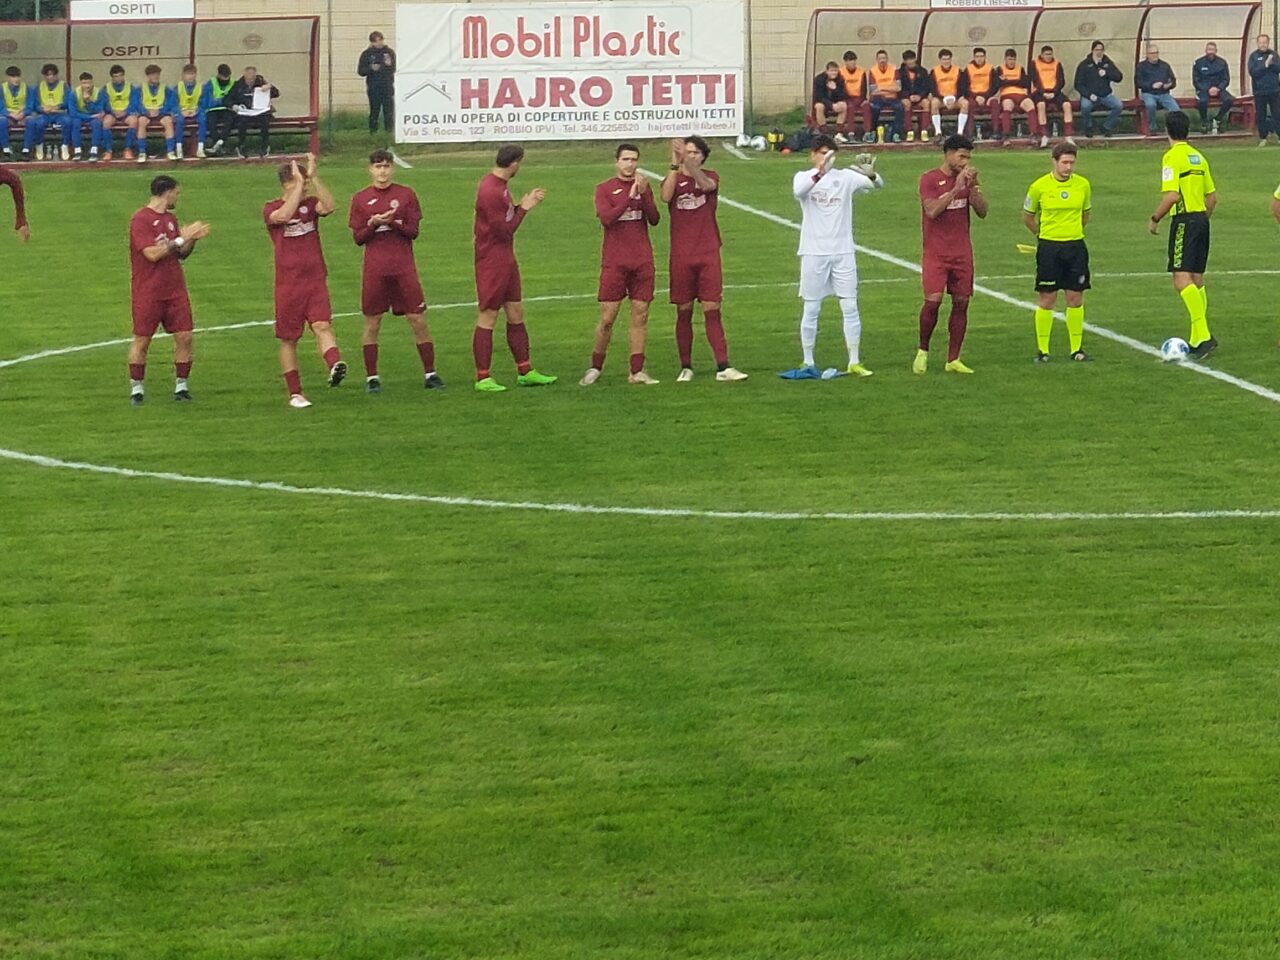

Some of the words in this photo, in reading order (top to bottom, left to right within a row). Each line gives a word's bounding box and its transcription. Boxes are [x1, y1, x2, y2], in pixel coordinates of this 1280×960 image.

[109, 3, 156, 15] OSPITI
[463, 15, 561, 59] Mobil
[573, 15, 681, 57] Plastic
[102, 45, 160, 56] OSPITI
[460, 76, 613, 110] HAJRO
[626, 74, 736, 107] TETTI
[403, 114, 439, 125] POSA
[443, 114, 457, 123] IN
[461, 113, 504, 124] OPERA
[507, 112, 520, 122] DI
[524, 111, 599, 122] COPERTURE
[603, 111, 610, 121] E
[614, 109, 698, 121] COSTRUZIONI
[702, 108, 736, 119] TETTI
[403, 128, 419, 137] Via
[468, 126, 485, 135] 123
[494, 125, 532, 134] ROBBIO
